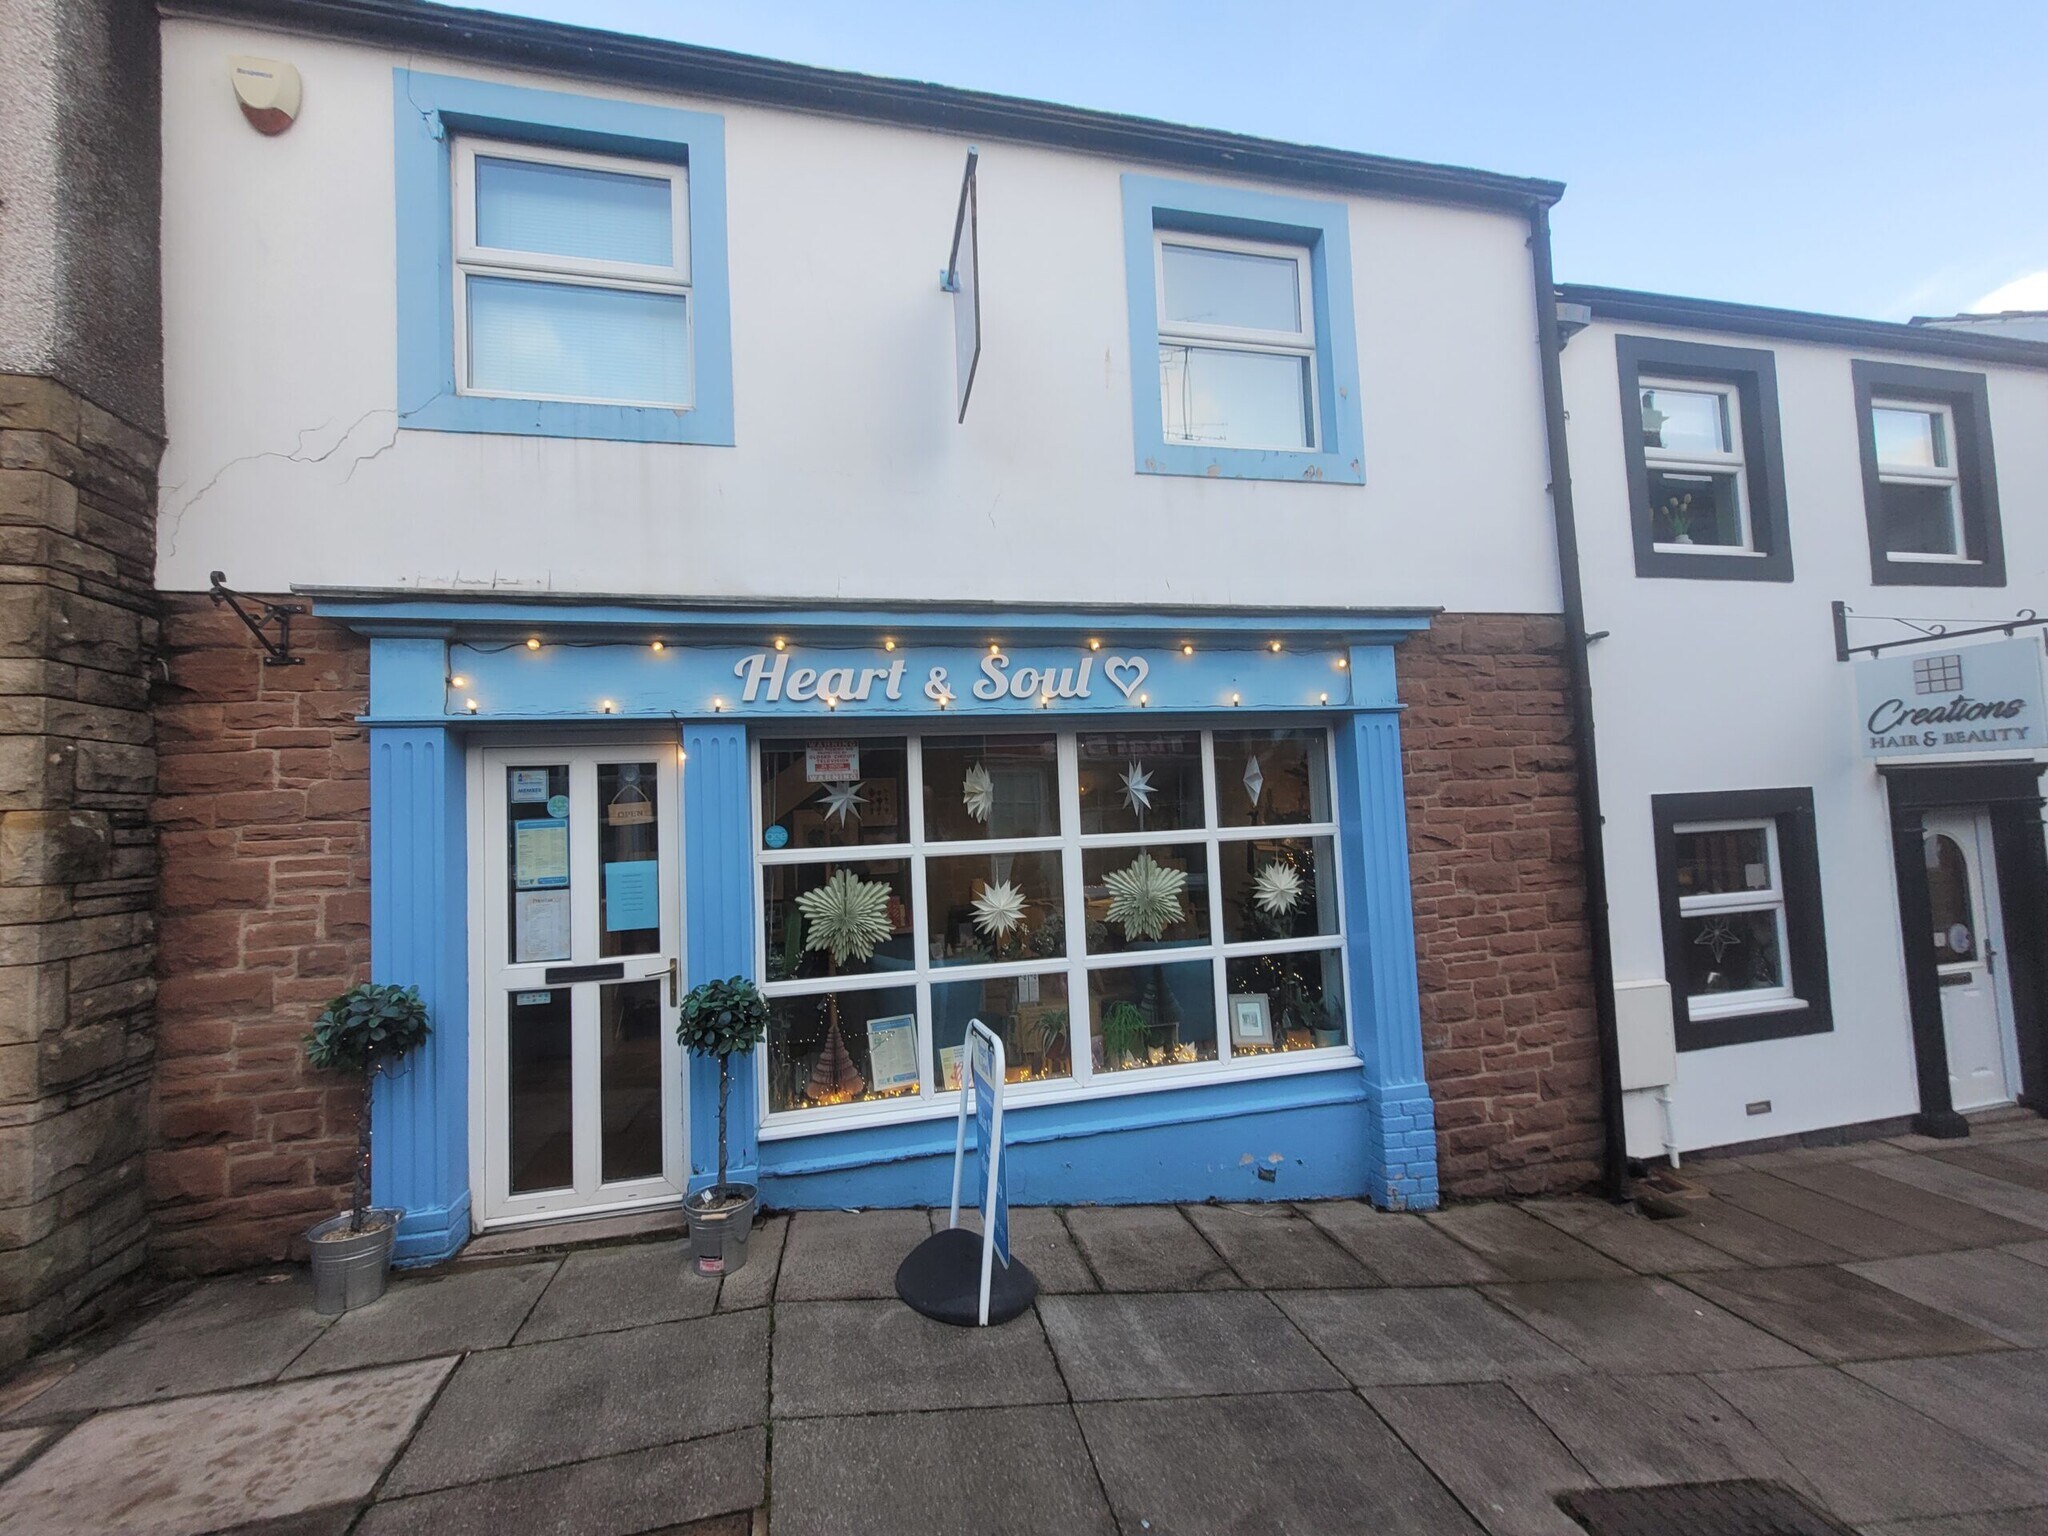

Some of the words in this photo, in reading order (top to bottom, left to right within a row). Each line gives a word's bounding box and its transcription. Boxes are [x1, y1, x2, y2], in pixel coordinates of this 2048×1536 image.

[734, 653, 905, 701] Heart
[924, 666, 957, 701] &
[972, 654, 1093, 700] Soul
[1867, 694, 2027, 735] Creations
[1870, 734, 1919, 749] HAIR
[1923, 731, 1938, 747] &
[1943, 726, 2030, 745] BEAUTY
[617, 810, 644, 819] OPEN
